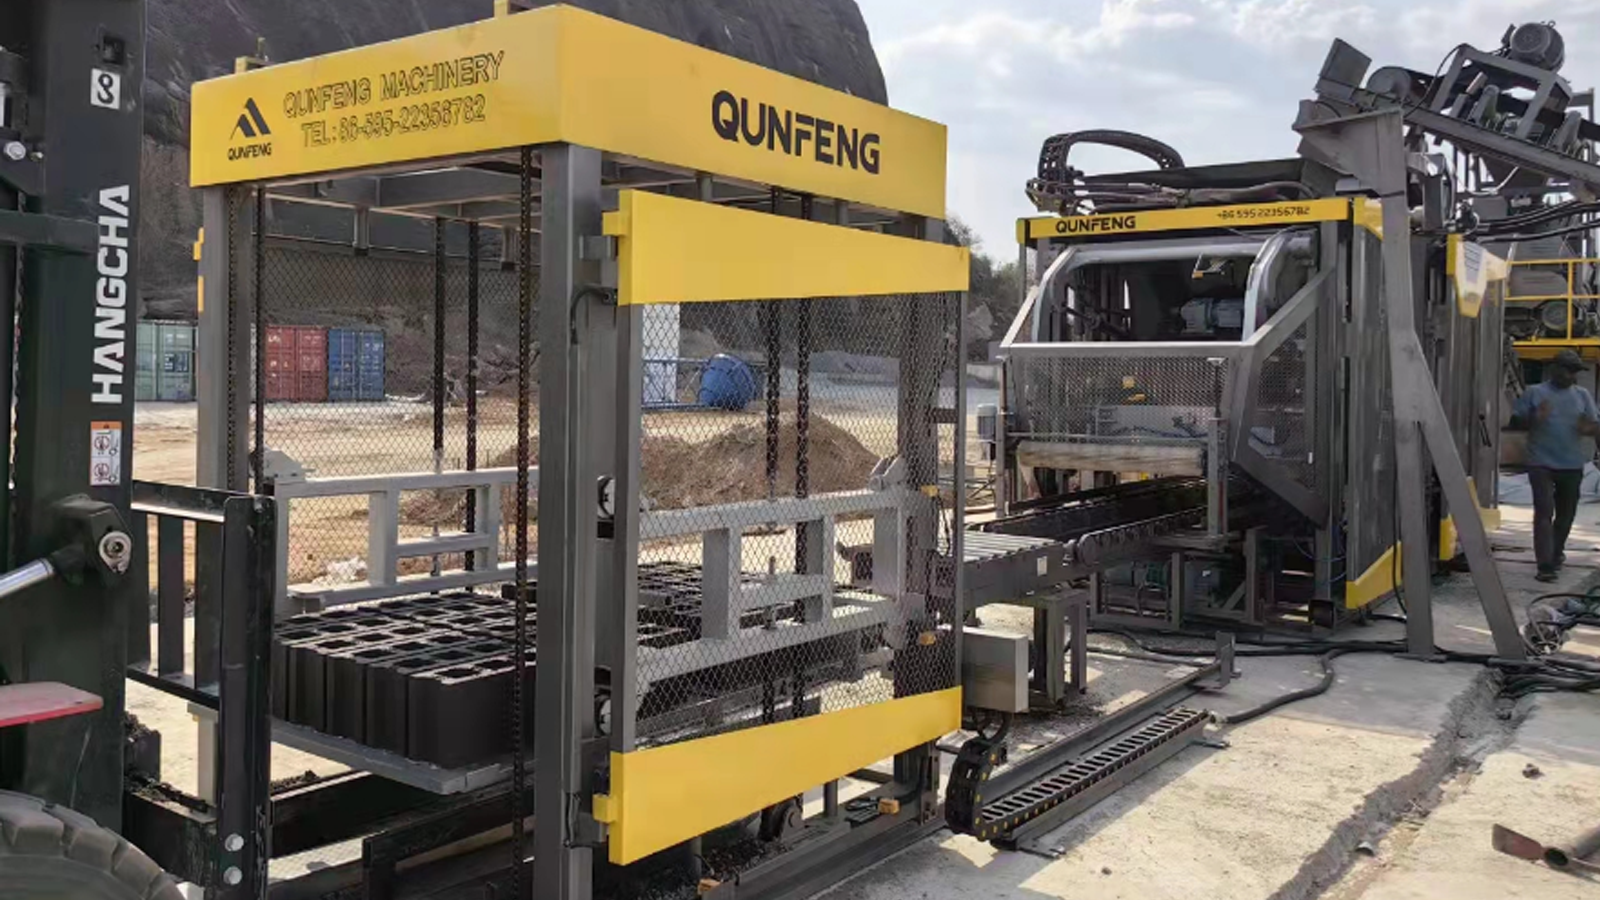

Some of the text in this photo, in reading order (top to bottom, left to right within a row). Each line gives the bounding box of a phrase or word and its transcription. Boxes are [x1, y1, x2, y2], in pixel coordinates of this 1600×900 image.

[283, 50, 505, 118] QUNFENG MACHINERY
[228, 142, 272, 160] QUNFENG
[711, 90, 880, 175] QUNFENG
[1055, 215, 1136, 233] QUNFENG
[91, 184, 130, 404] HANGCHA
